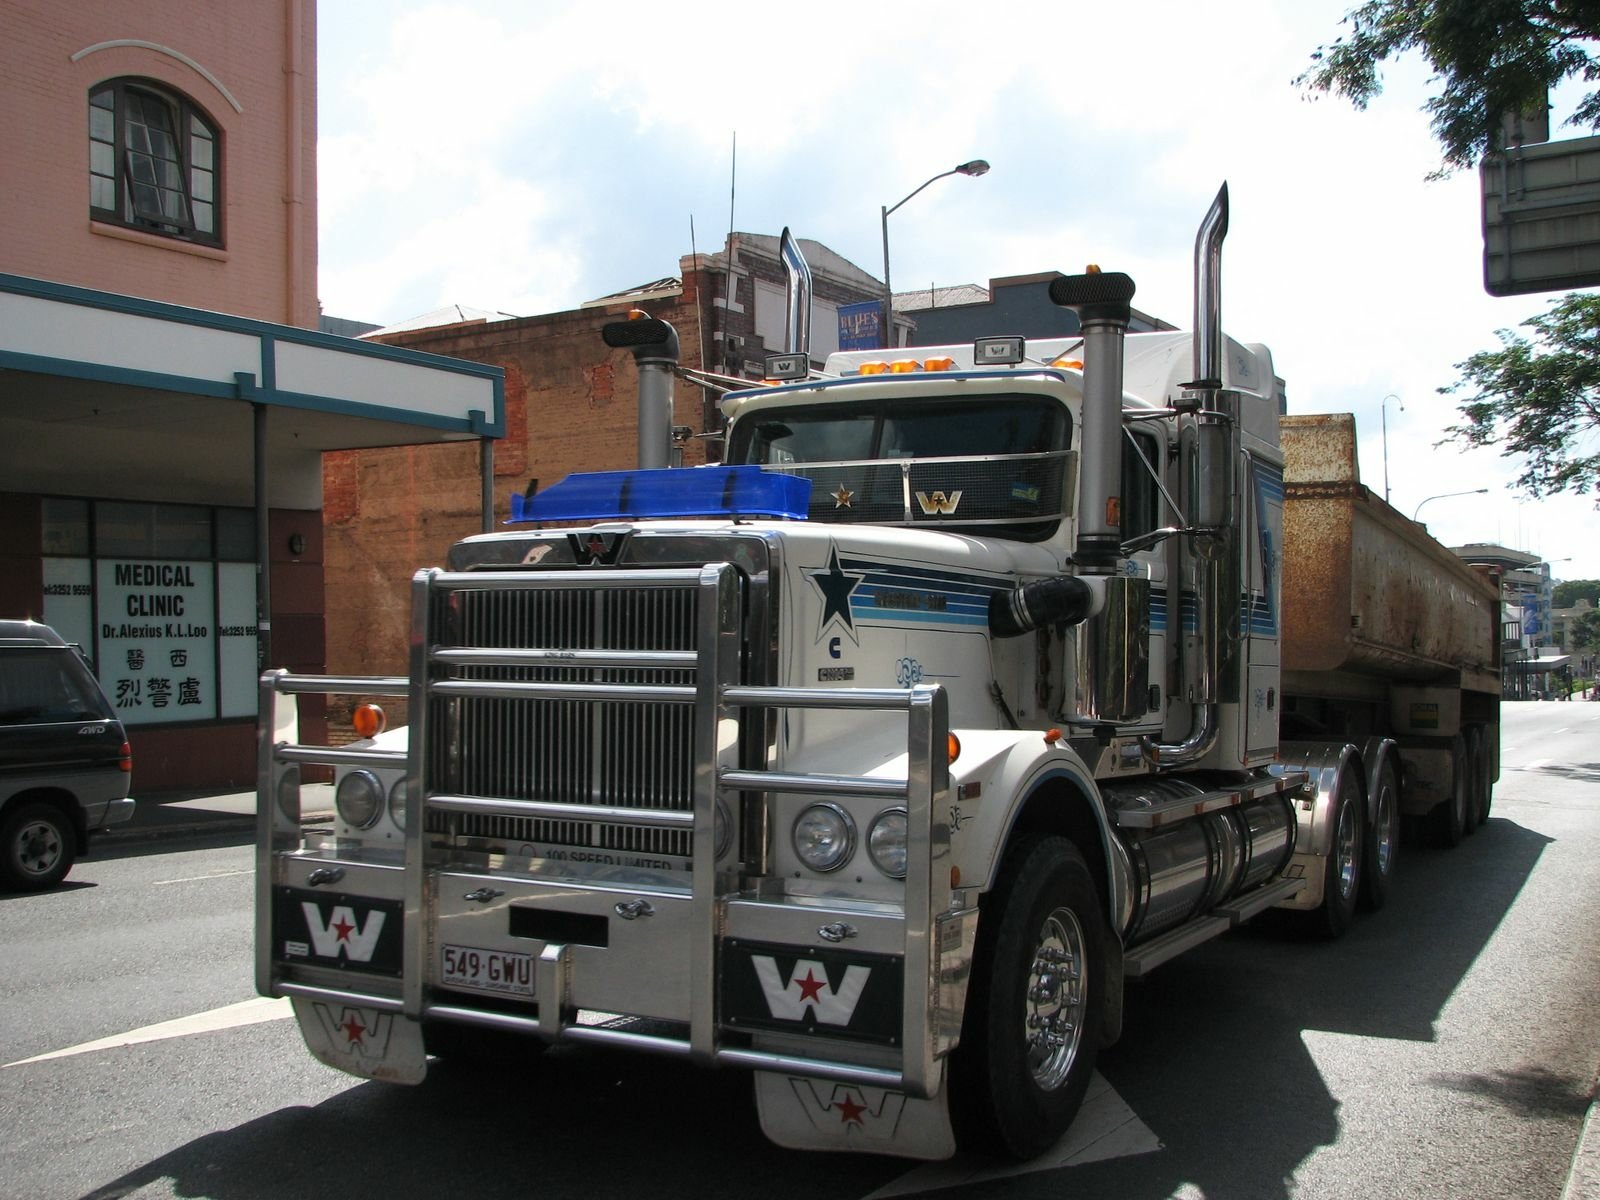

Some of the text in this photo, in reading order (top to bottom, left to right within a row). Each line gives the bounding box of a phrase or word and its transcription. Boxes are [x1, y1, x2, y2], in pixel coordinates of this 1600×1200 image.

[115, 564, 195, 588] MEDICAL
[126, 594, 185, 617] CLINIC
[102, 623, 208, 639] Dr.Alexius K.L.Loo
